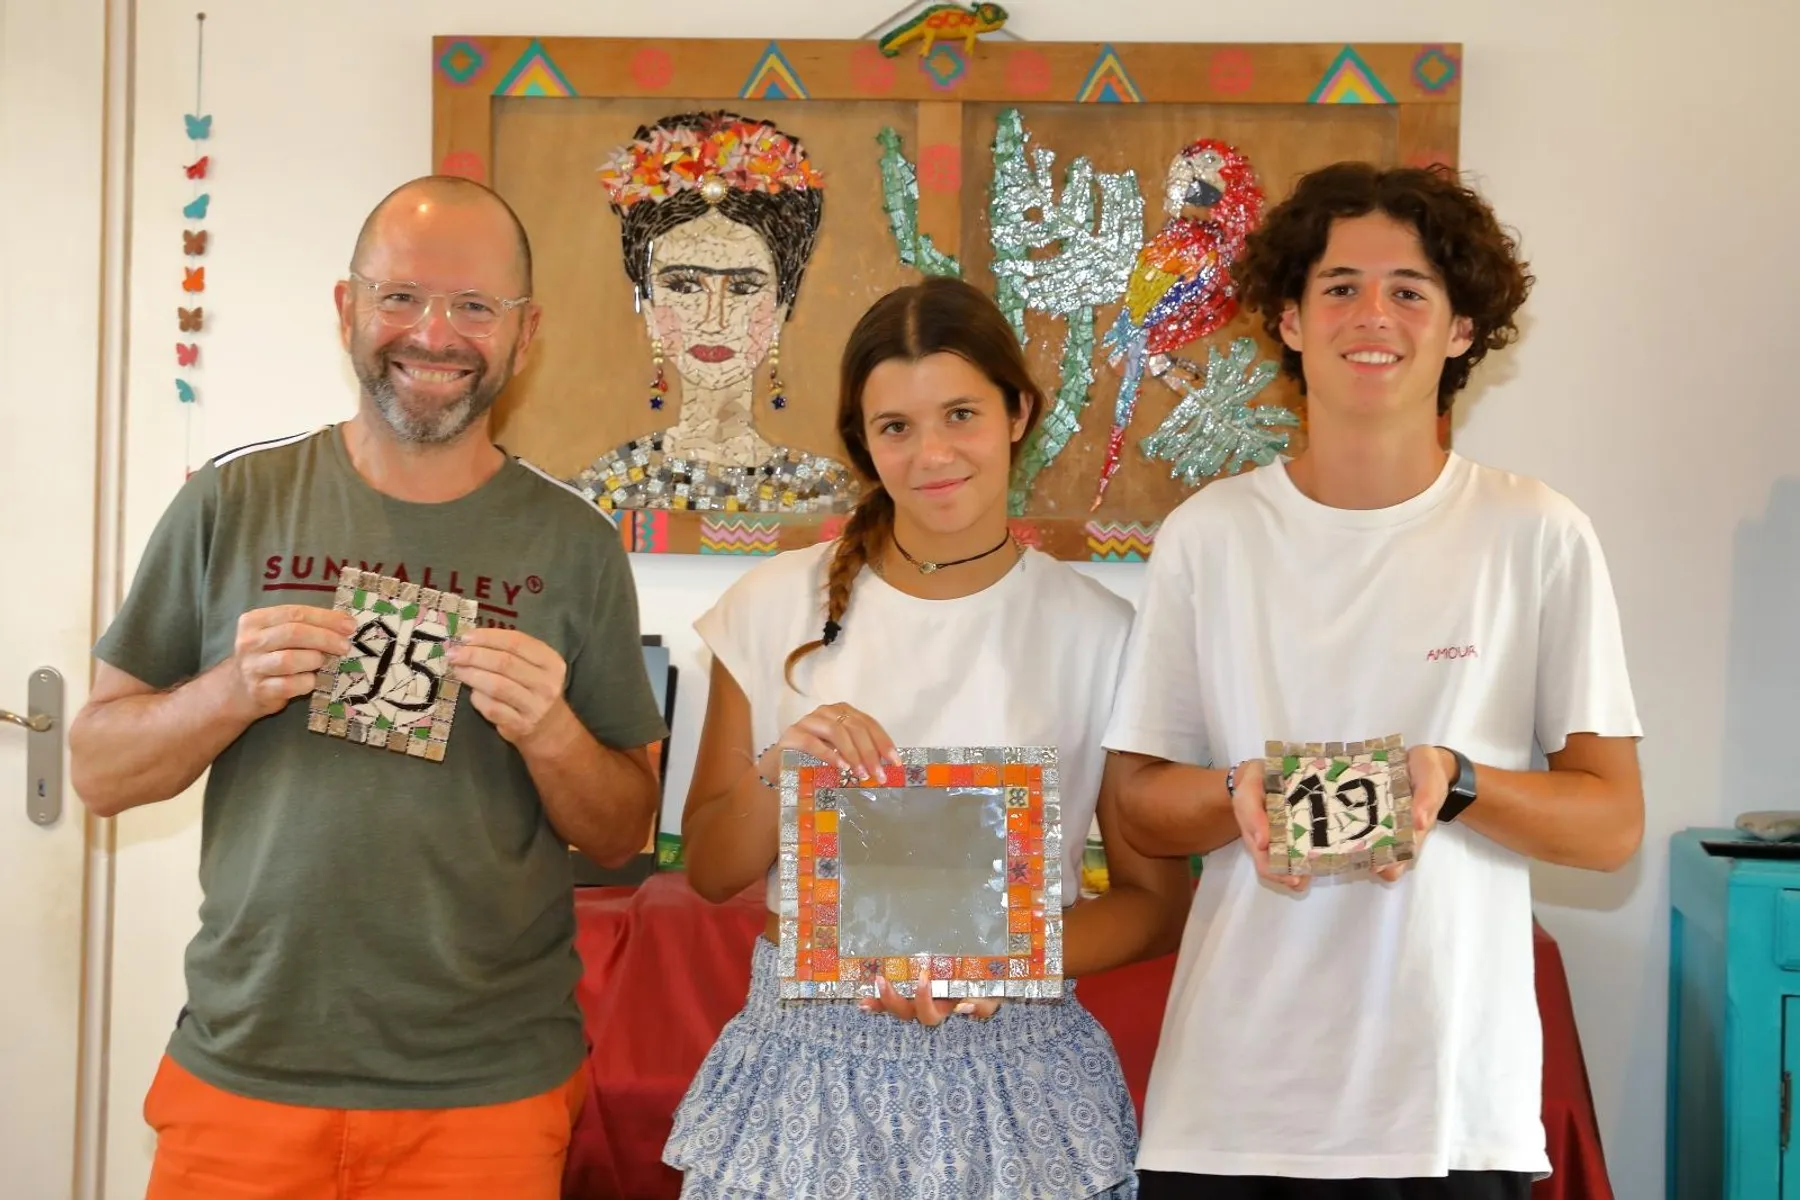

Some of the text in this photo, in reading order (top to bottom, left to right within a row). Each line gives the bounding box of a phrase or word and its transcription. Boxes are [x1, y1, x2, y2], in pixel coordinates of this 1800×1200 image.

[345, 619, 447, 711] 95
[1426, 645, 1478, 661] AMOUR
[1287, 774, 1377, 847] 19
